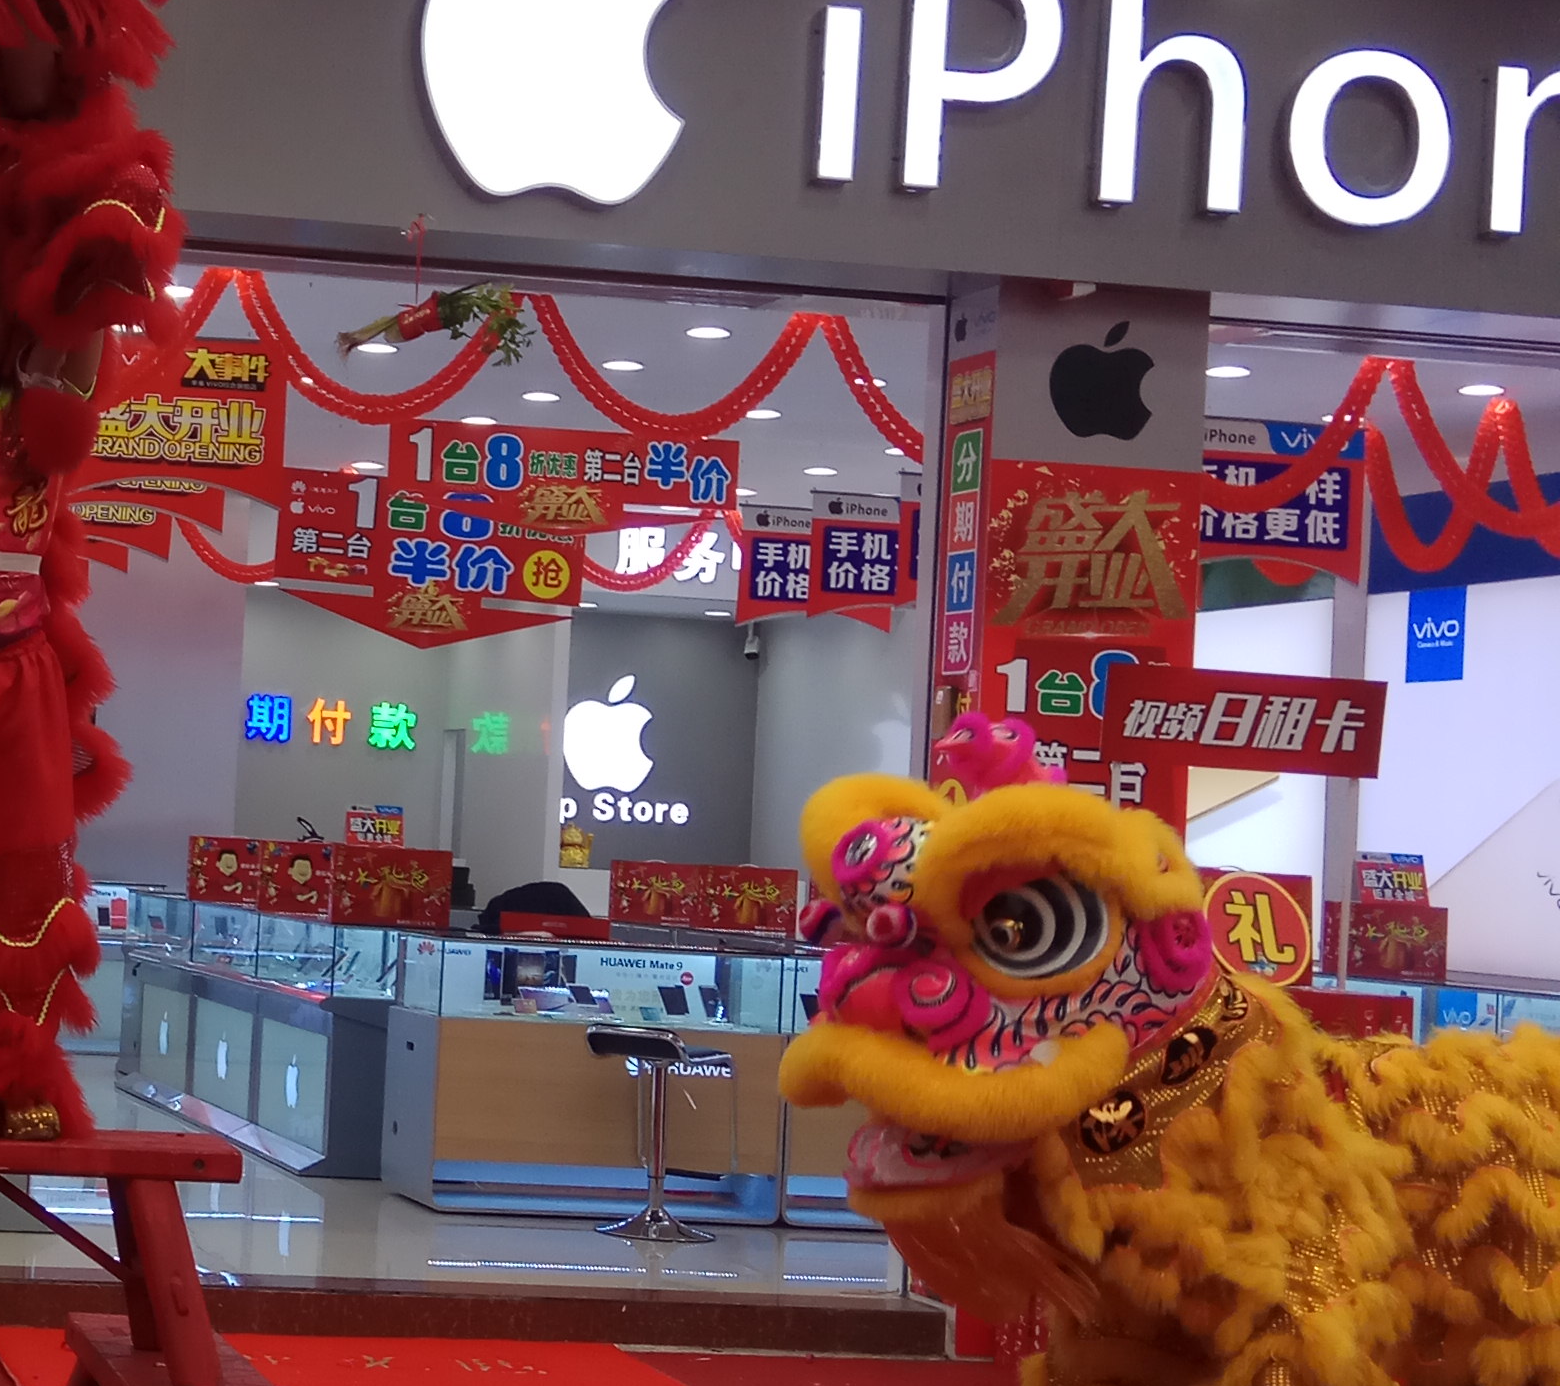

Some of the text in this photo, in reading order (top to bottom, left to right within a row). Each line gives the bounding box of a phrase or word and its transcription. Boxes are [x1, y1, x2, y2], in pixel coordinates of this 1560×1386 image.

[184, 348, 270, 383] 大事件
[163, 439, 263, 464] OPENING
[772, 514, 812, 529] iPhone
[845, 502, 889, 517] iPhone
[756, 542, 811, 569] 手机
[828, 530, 892, 561] 手机
[947, 440, 980, 665] 分期付款
[531, 557, 565, 589] 抢
[827, 561, 891, 592] 价格
[1412, 616, 1460, 640] vivo
[247, 693, 418, 752] 期付款
[1123, 691, 1366, 754] 视频日租卡
[592, 791, 690, 825] Store
[1224, 890, 1296, 964] 礼
[600, 956, 684, 971] HUAWEI Mate 9
